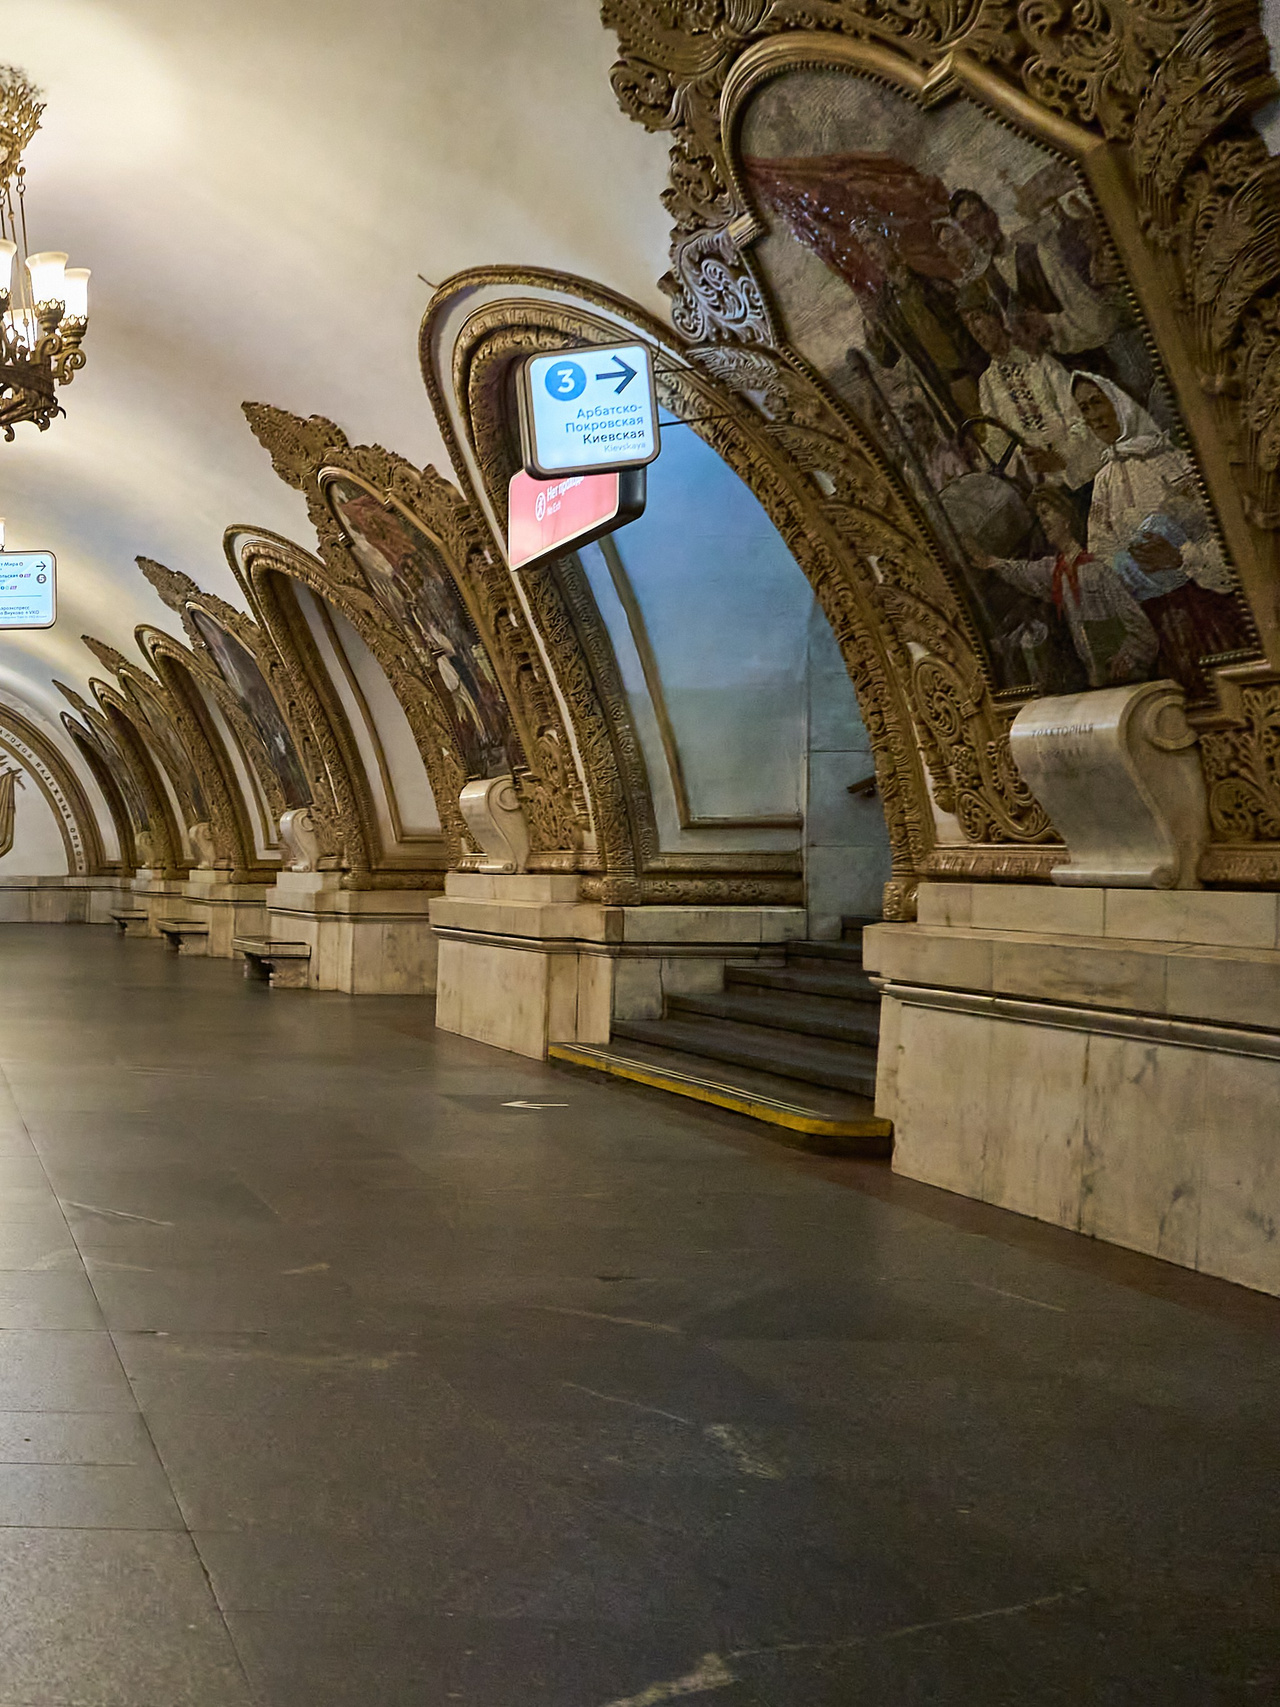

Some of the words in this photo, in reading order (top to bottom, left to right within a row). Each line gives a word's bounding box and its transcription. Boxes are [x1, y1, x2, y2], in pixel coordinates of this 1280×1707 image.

[557, 368, 575, 393] 3
[577, 404, 642, 420] Арбатско-
[565, 416, 644, 433] Покровская
[583, 430, 645, 444] Киевская
[604, 442, 646, 453] Kievskaya
